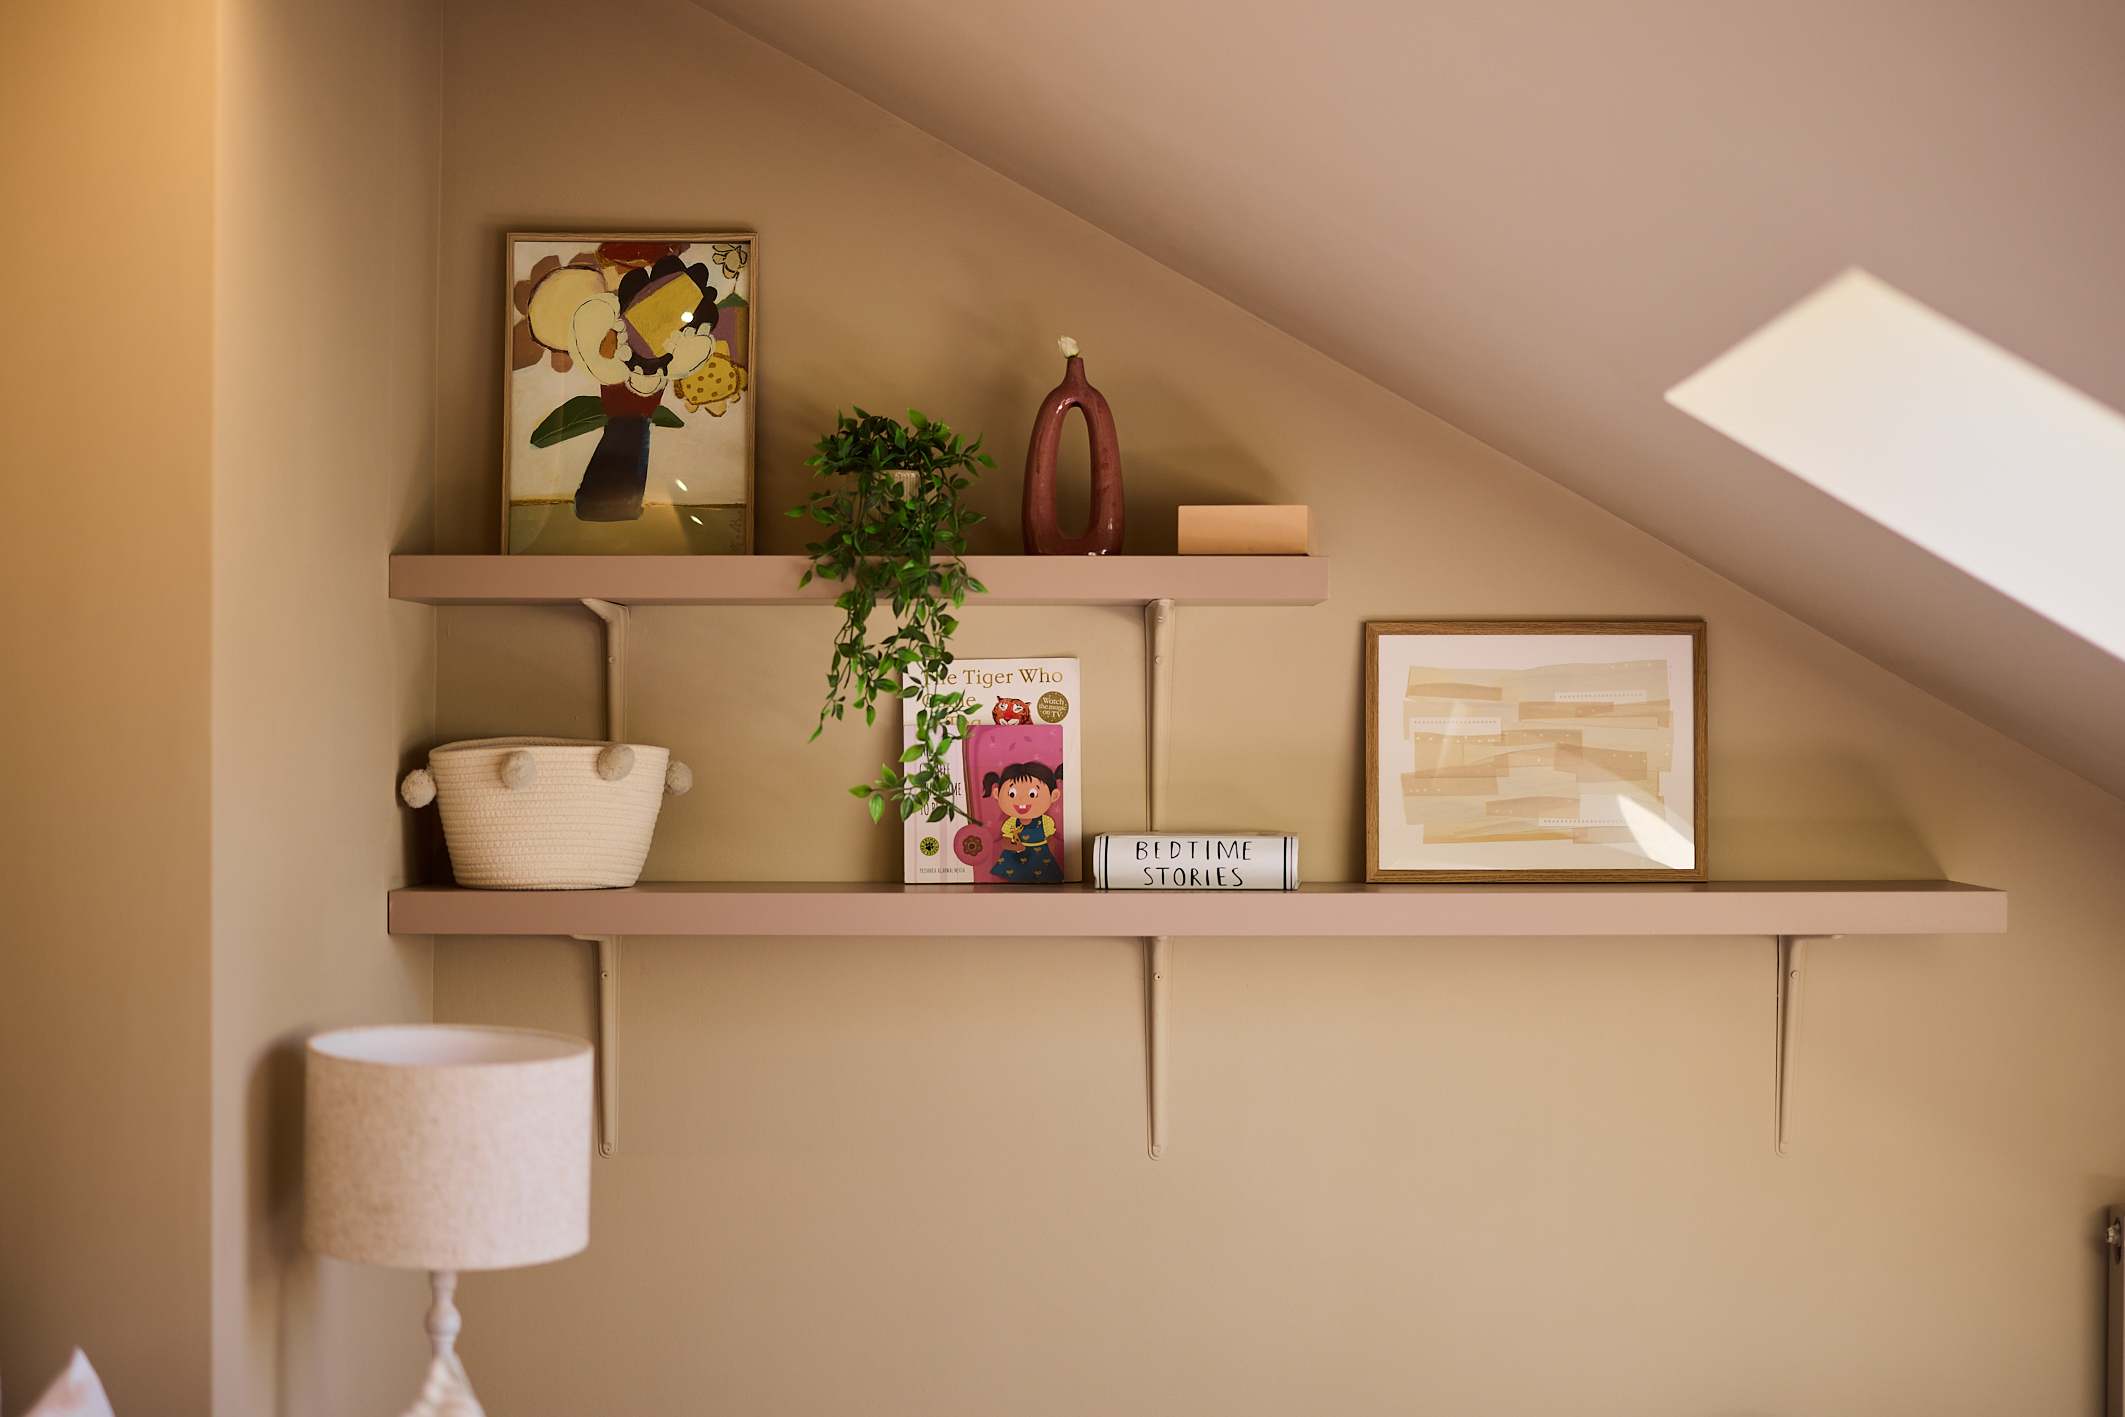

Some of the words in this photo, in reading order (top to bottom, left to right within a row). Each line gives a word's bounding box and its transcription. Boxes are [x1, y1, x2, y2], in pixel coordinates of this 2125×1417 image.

[963, 669, 1013, 688] Tiger
[1018, 667, 1063, 683] Who
[1042, 696, 1064, 705] Watch
[1136, 840, 1253, 861] BEDTIME
[1143, 866, 1244, 887] STORIES
